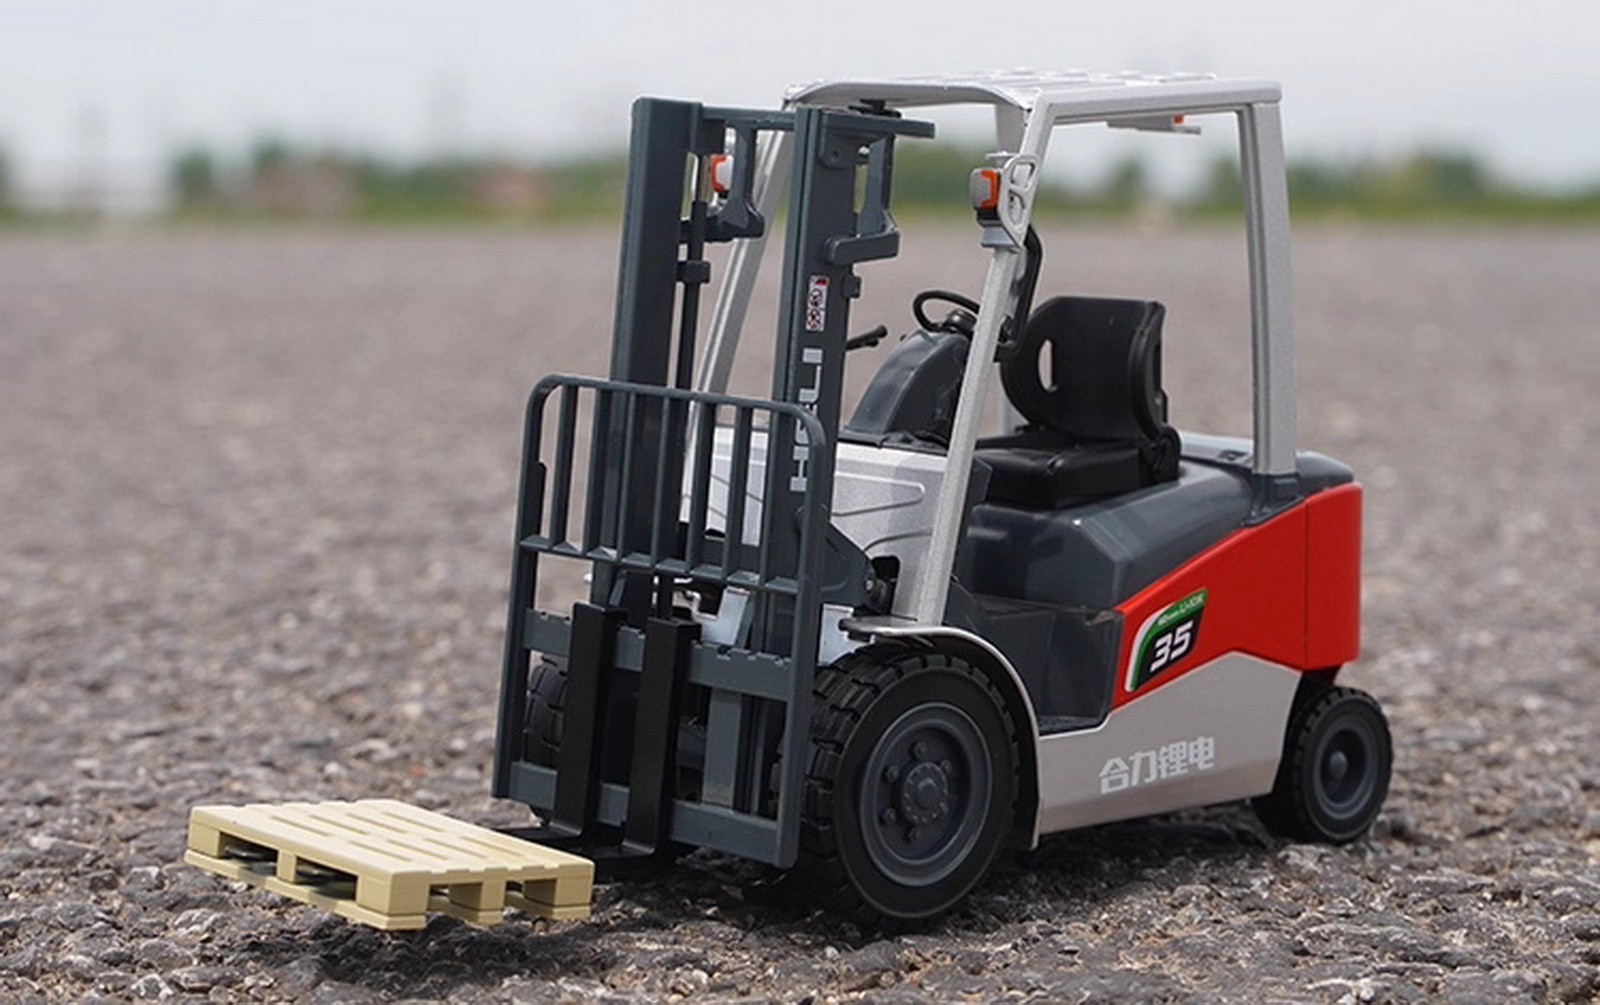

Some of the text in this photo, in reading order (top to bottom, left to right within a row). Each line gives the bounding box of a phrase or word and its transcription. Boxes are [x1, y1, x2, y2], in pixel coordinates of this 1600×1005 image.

[1150, 620, 1194, 673] 35
[1098, 736, 1215, 794] 合力锂电
